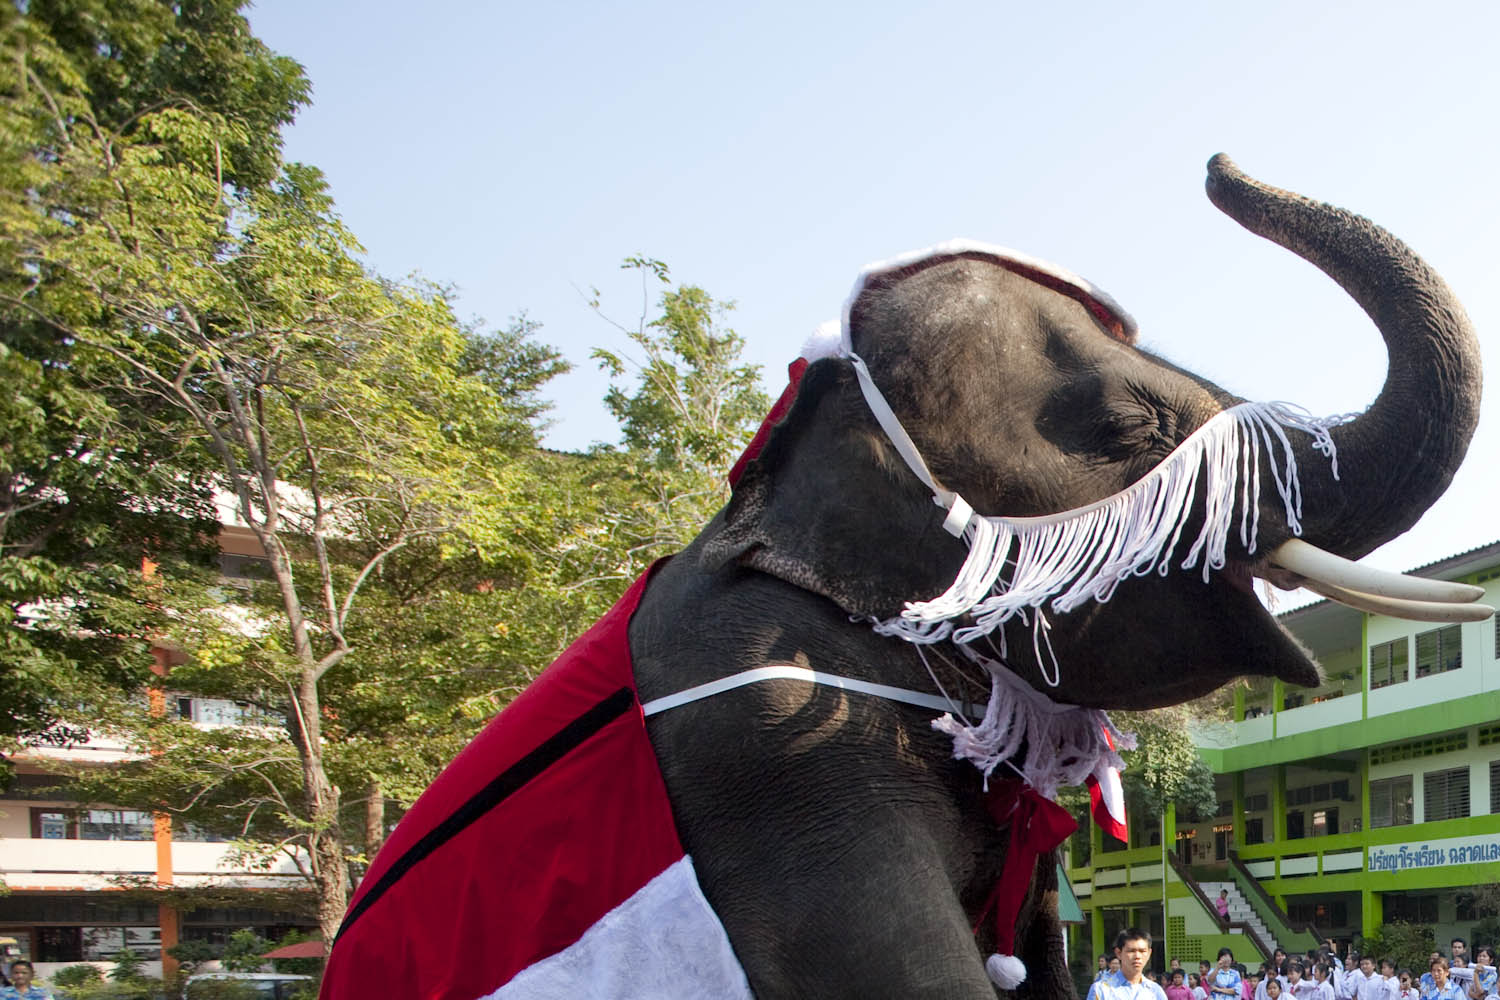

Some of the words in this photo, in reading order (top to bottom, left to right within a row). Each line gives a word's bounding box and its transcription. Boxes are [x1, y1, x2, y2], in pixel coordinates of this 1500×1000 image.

[1368, 844, 1446, 875] ปรัชญาโรงเรียน
